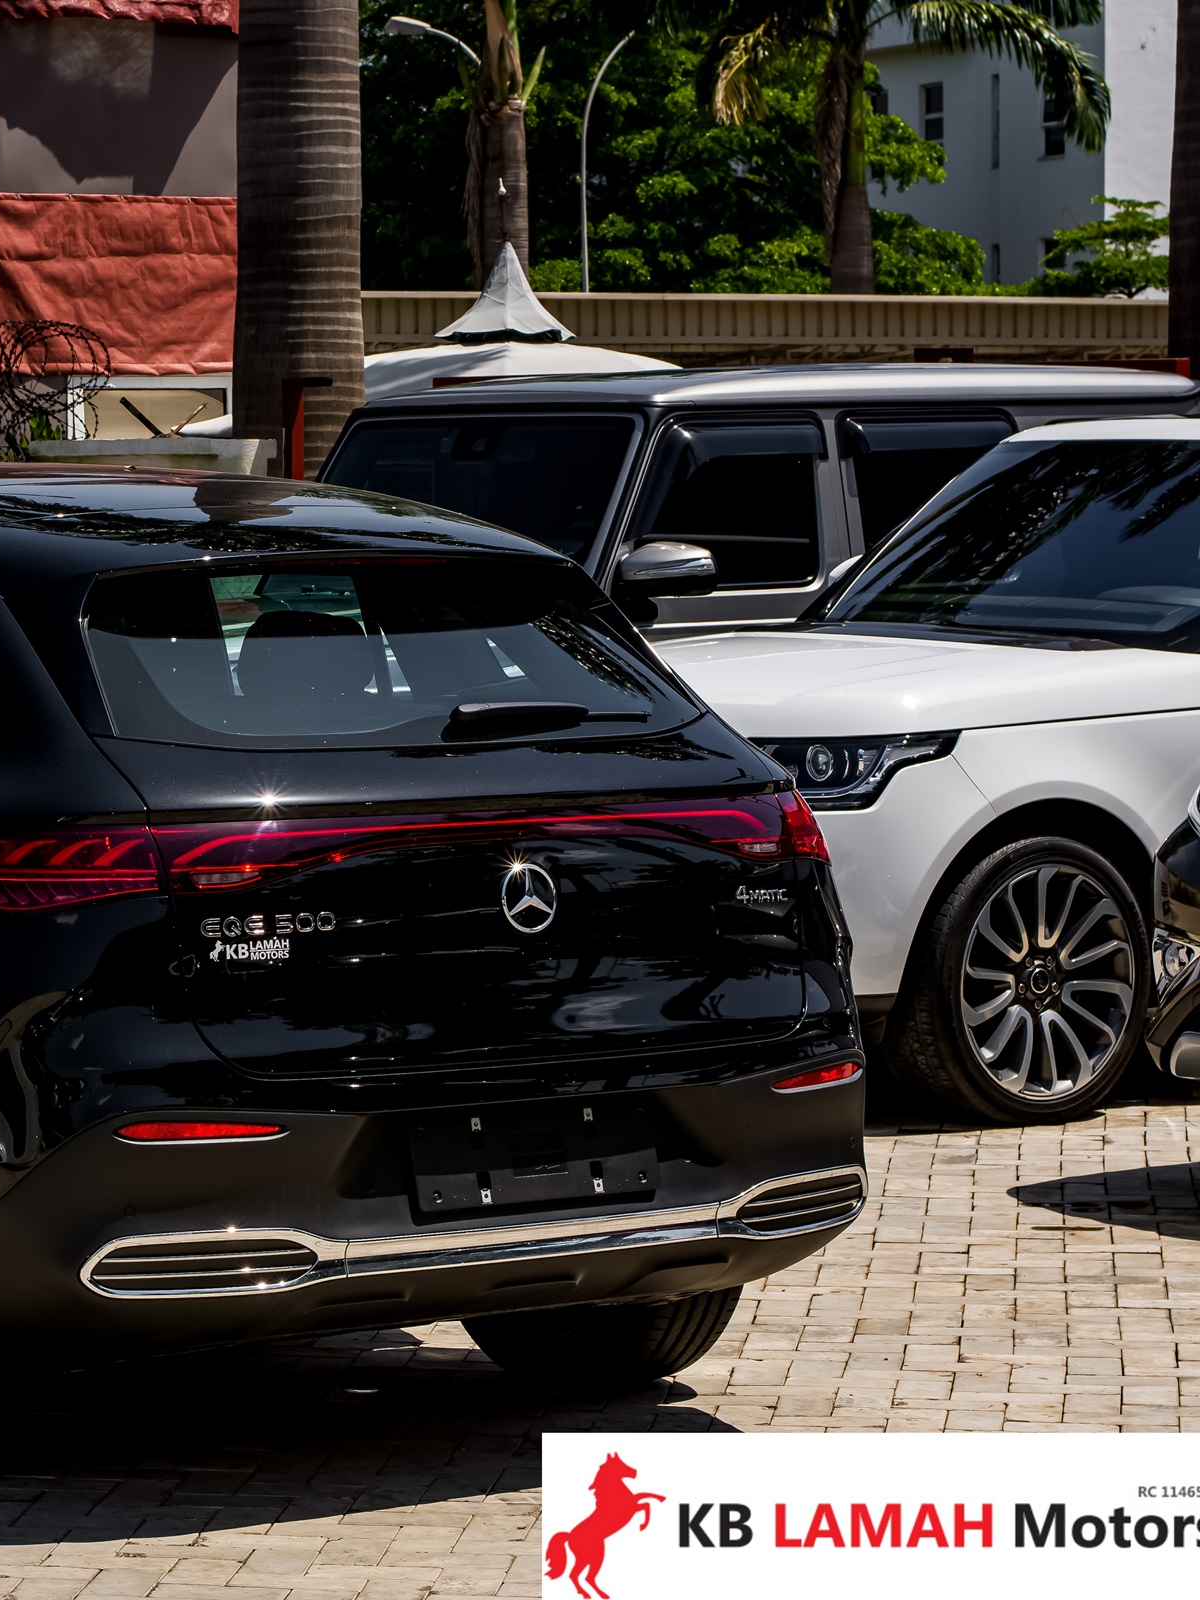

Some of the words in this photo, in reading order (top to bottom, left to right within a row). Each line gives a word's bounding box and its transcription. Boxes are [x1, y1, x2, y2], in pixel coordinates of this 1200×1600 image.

[736, 885, 788, 904] 4MATIC
[200, 915, 265, 938] EQE
[275, 911, 336, 935] 500
[225, 943, 250, 960] KB
[250, 938, 290, 950] LAMAH
[250, 950, 290, 961] MOTORS
